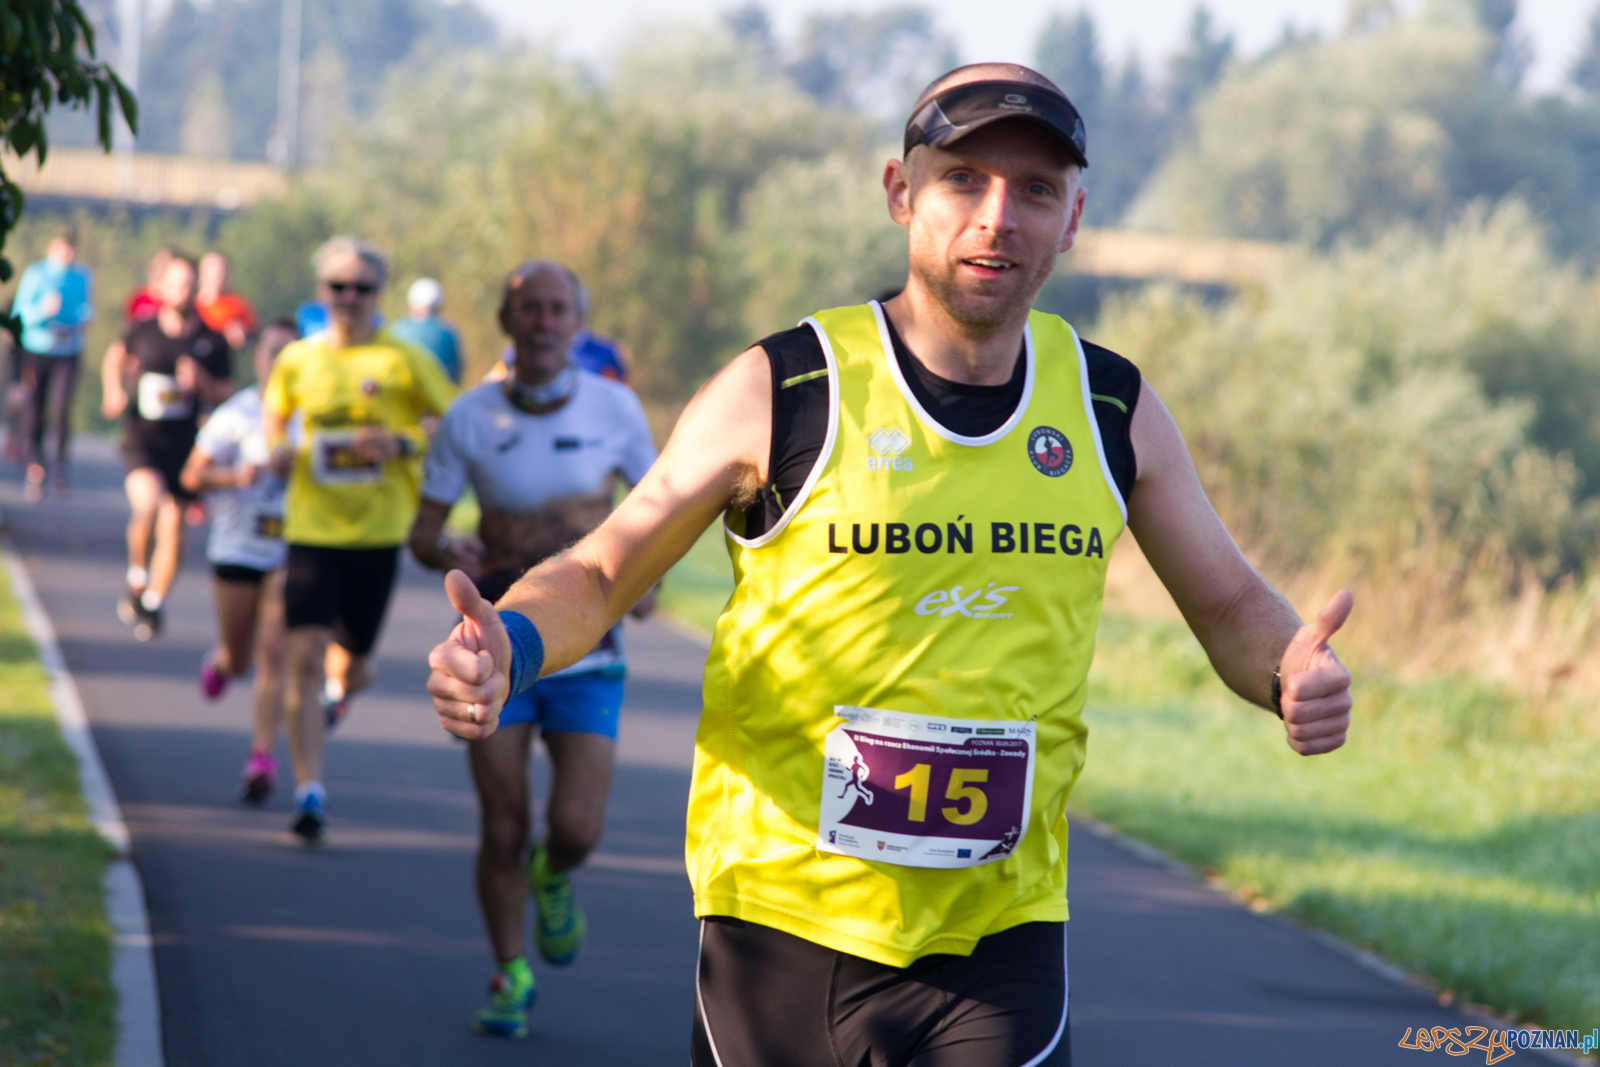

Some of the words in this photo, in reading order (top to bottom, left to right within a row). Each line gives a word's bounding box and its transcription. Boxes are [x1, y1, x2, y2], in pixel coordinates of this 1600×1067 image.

[828, 515, 973, 555] LUBOŃ
[991, 521, 1104, 559] BIEGA
[860, 735, 875, 746] Bieg
[875, 739, 883, 747] na
[884, 740, 902, 749] rzecz
[902, 742, 935, 753] Ekonomii
[894, 763, 989, 826] 15
